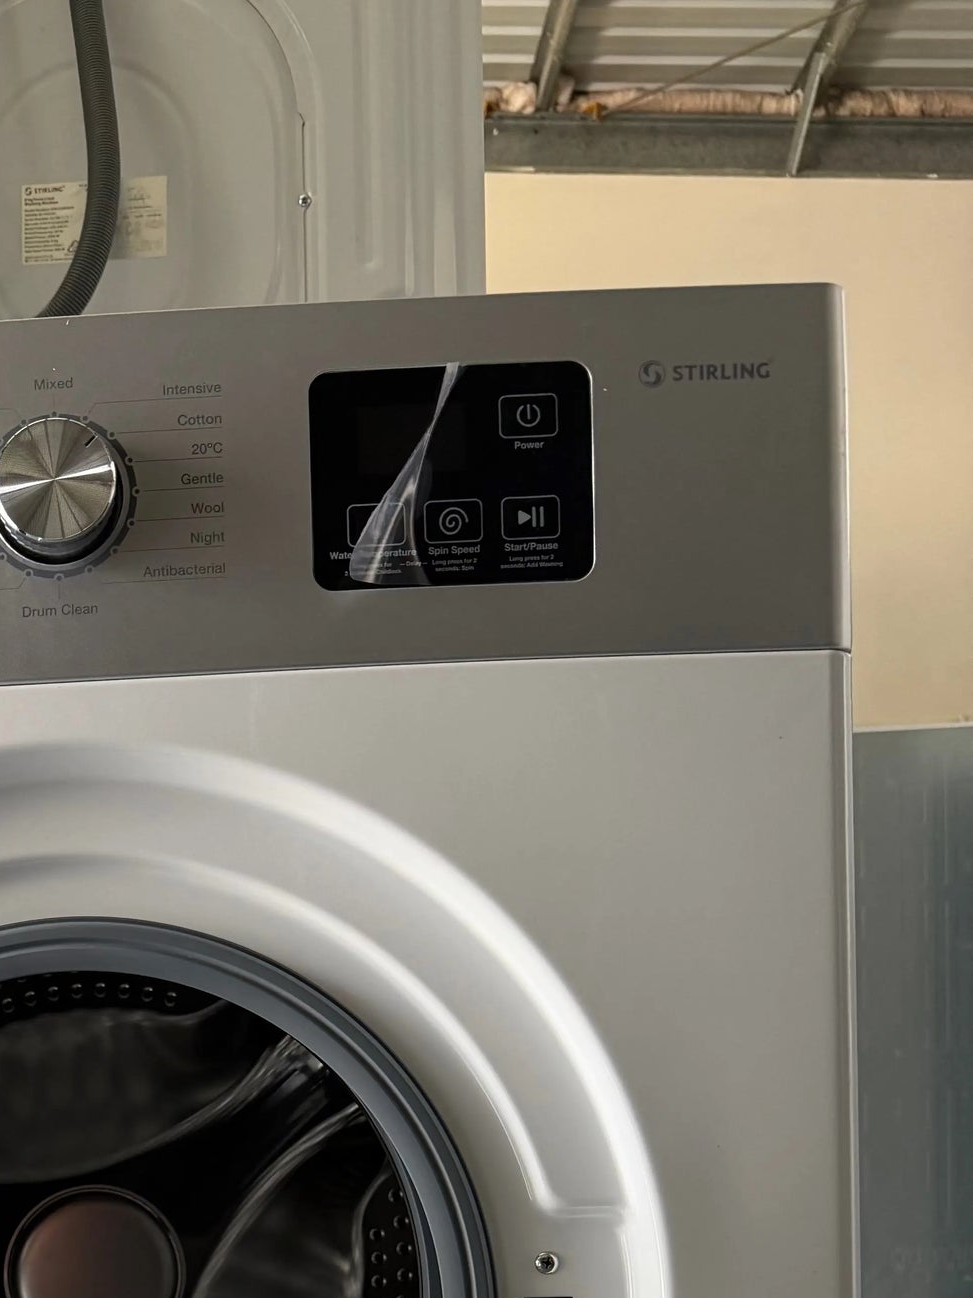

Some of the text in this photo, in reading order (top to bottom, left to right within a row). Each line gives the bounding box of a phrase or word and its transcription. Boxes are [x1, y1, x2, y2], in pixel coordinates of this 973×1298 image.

[672, 362, 771, 382] STIRLING
[33, 378, 73, 391] Mixed
[162, 382, 221, 396] Intensive
[177, 413, 223, 426] Cotton
[514, 440, 544, 450] Power
[180, 472, 224, 485] Gentle
[191, 502, 224, 514] Wool
[190, 531, 225, 546] Night
[428, 544, 481, 557] Spin Speed
[504, 542, 558, 552] Start/Pause
[329, 551, 355, 560] Wate
[143, 563, 226, 578] Antibacterial
[22, 603, 98, 619] Drum Clean
